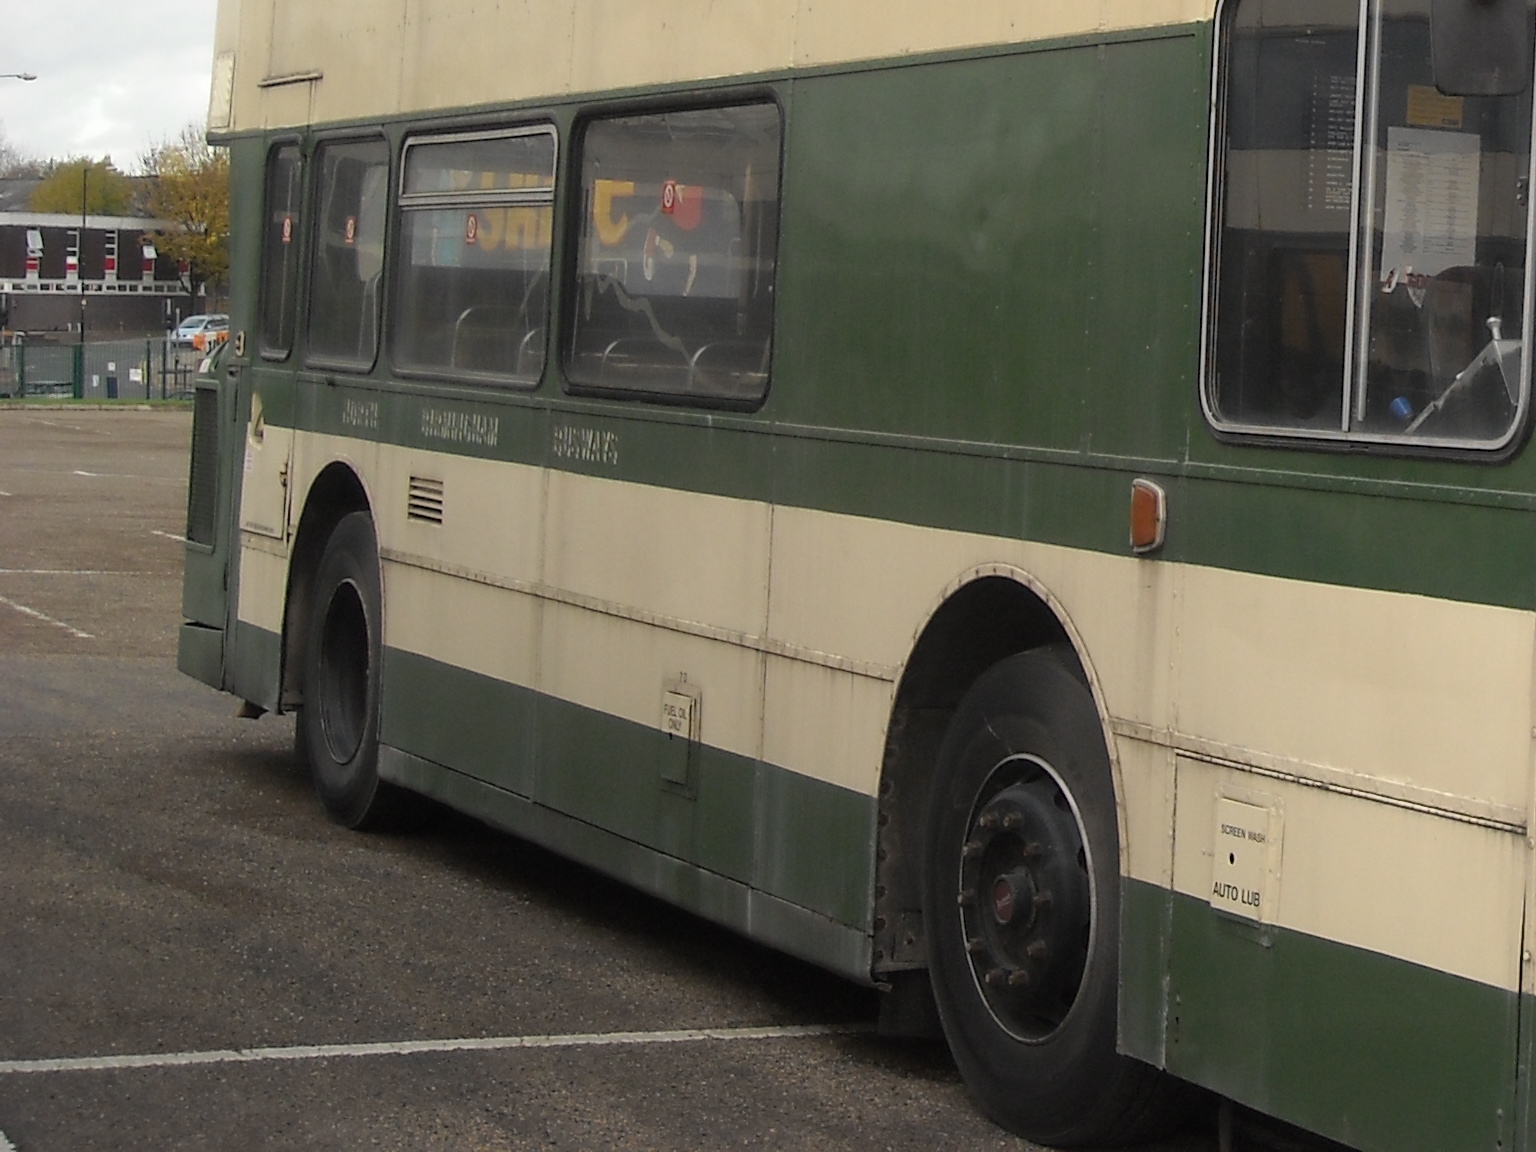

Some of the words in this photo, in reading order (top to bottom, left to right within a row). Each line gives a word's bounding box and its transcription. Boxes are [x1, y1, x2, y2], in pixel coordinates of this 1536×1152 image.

[1221, 824, 1247, 839] SCREEN
[1247, 831, 1266, 843] WASH
[1213, 881, 1239, 901] AUTO
[1241, 888, 1261, 907] LUB
